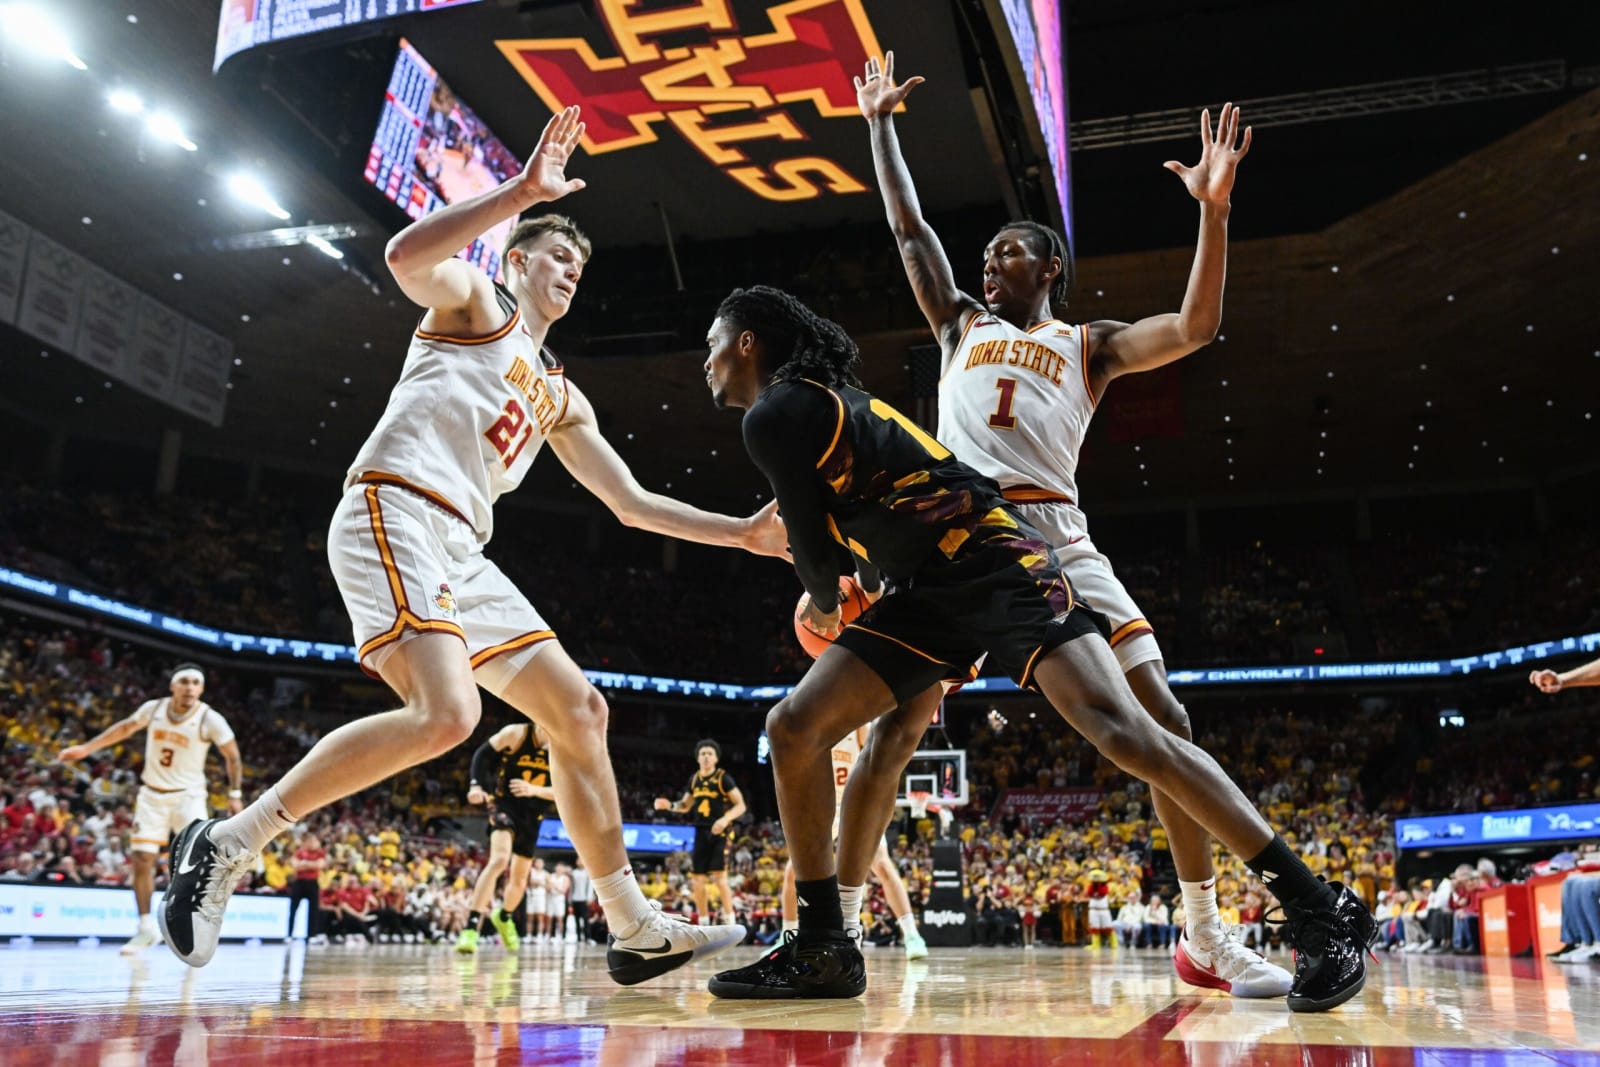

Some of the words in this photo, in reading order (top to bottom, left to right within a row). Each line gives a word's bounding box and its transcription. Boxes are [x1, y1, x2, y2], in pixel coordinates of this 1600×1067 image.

[504, 356, 534, 395] IOWA
[964, 339, 1008, 371] IOWA
[1008, 339, 1067, 388] STATE
[988, 377, 1018, 431] 1
[483, 398, 533, 471] 21
[1207, 668, 1304, 681] CHEVROLET
[1319, 665, 1361, 678] PREMIER
[1362, 664, 1395, 676] CHEVY
[1395, 662, 1440, 675] DEALERS
[160, 748, 174, 767] 3
[698, 799, 711, 817] 4
